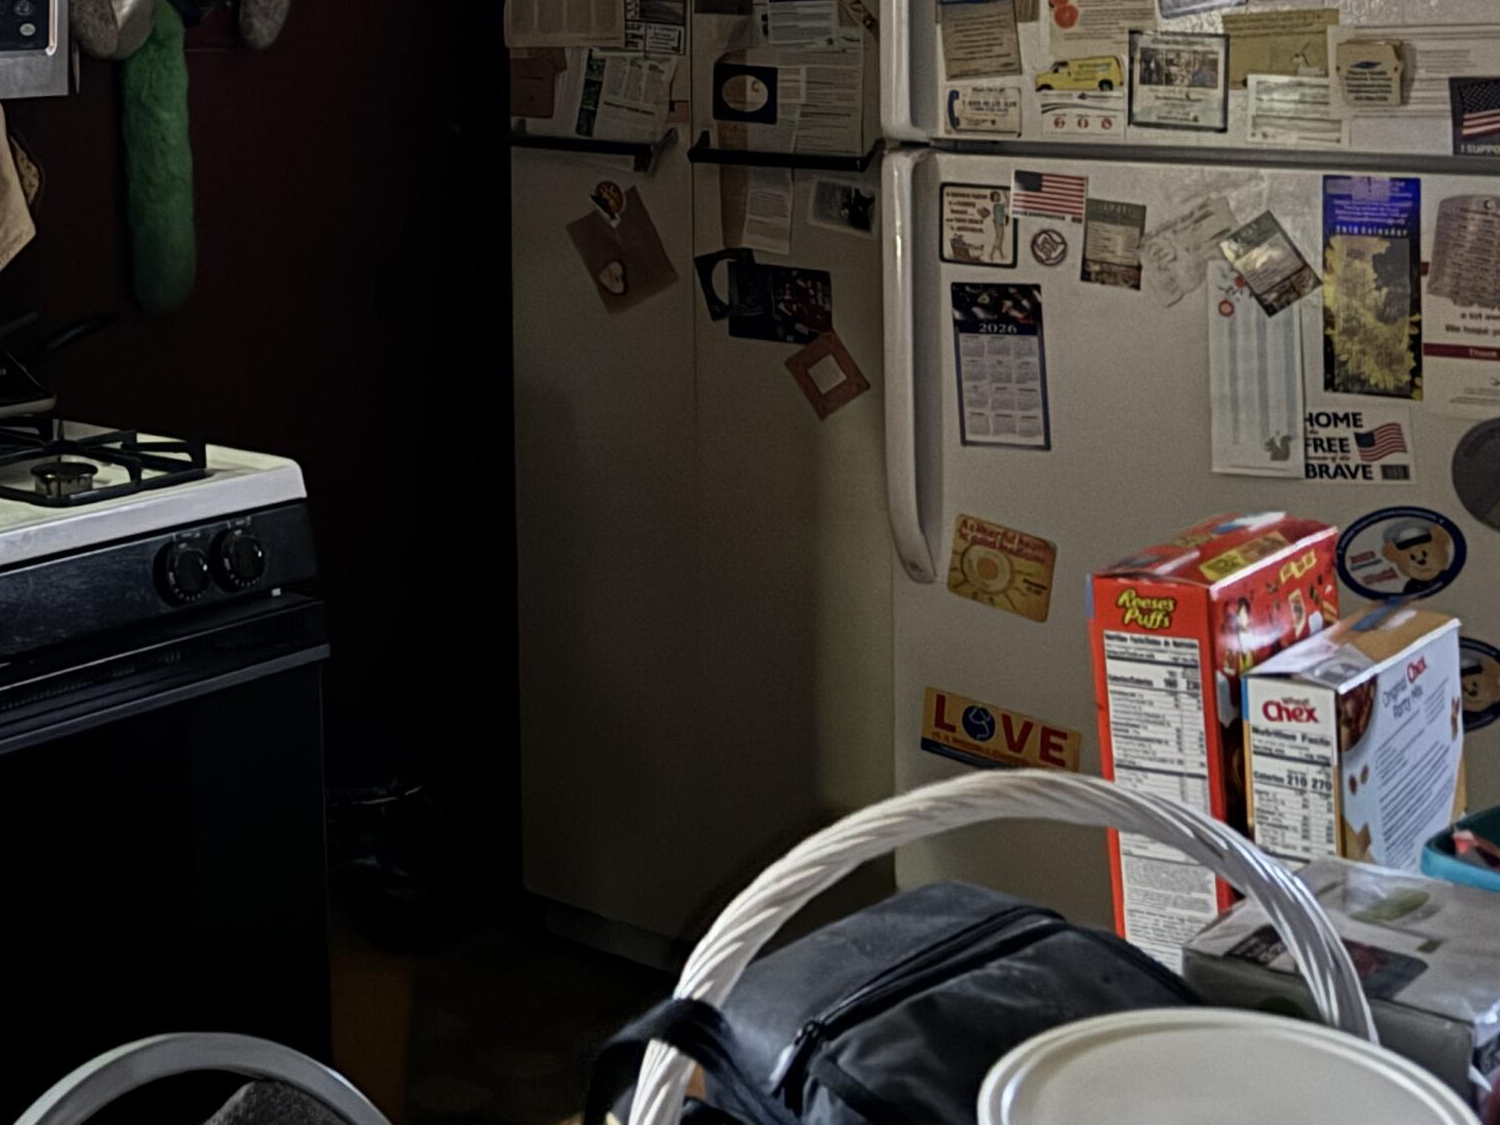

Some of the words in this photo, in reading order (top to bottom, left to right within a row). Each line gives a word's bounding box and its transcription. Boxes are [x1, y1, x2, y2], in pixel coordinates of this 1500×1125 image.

[1467, 143, 1500, 154] SUPPO
[978, 322, 1018, 334] 2026
[1305, 437, 1350, 454] FREE
[1305, 463, 1374, 481] BRAVE
[1123, 608, 1171, 629] Puffs
[1262, 700, 1320, 723] Chex
[1252, 727, 1297, 741] Nutrition
[1301, 733, 1331, 746] Facts
[1254, 771, 1285, 784] Calories
[1287, 774, 1308, 787] 210
[1311, 778, 1332, 792] 270
